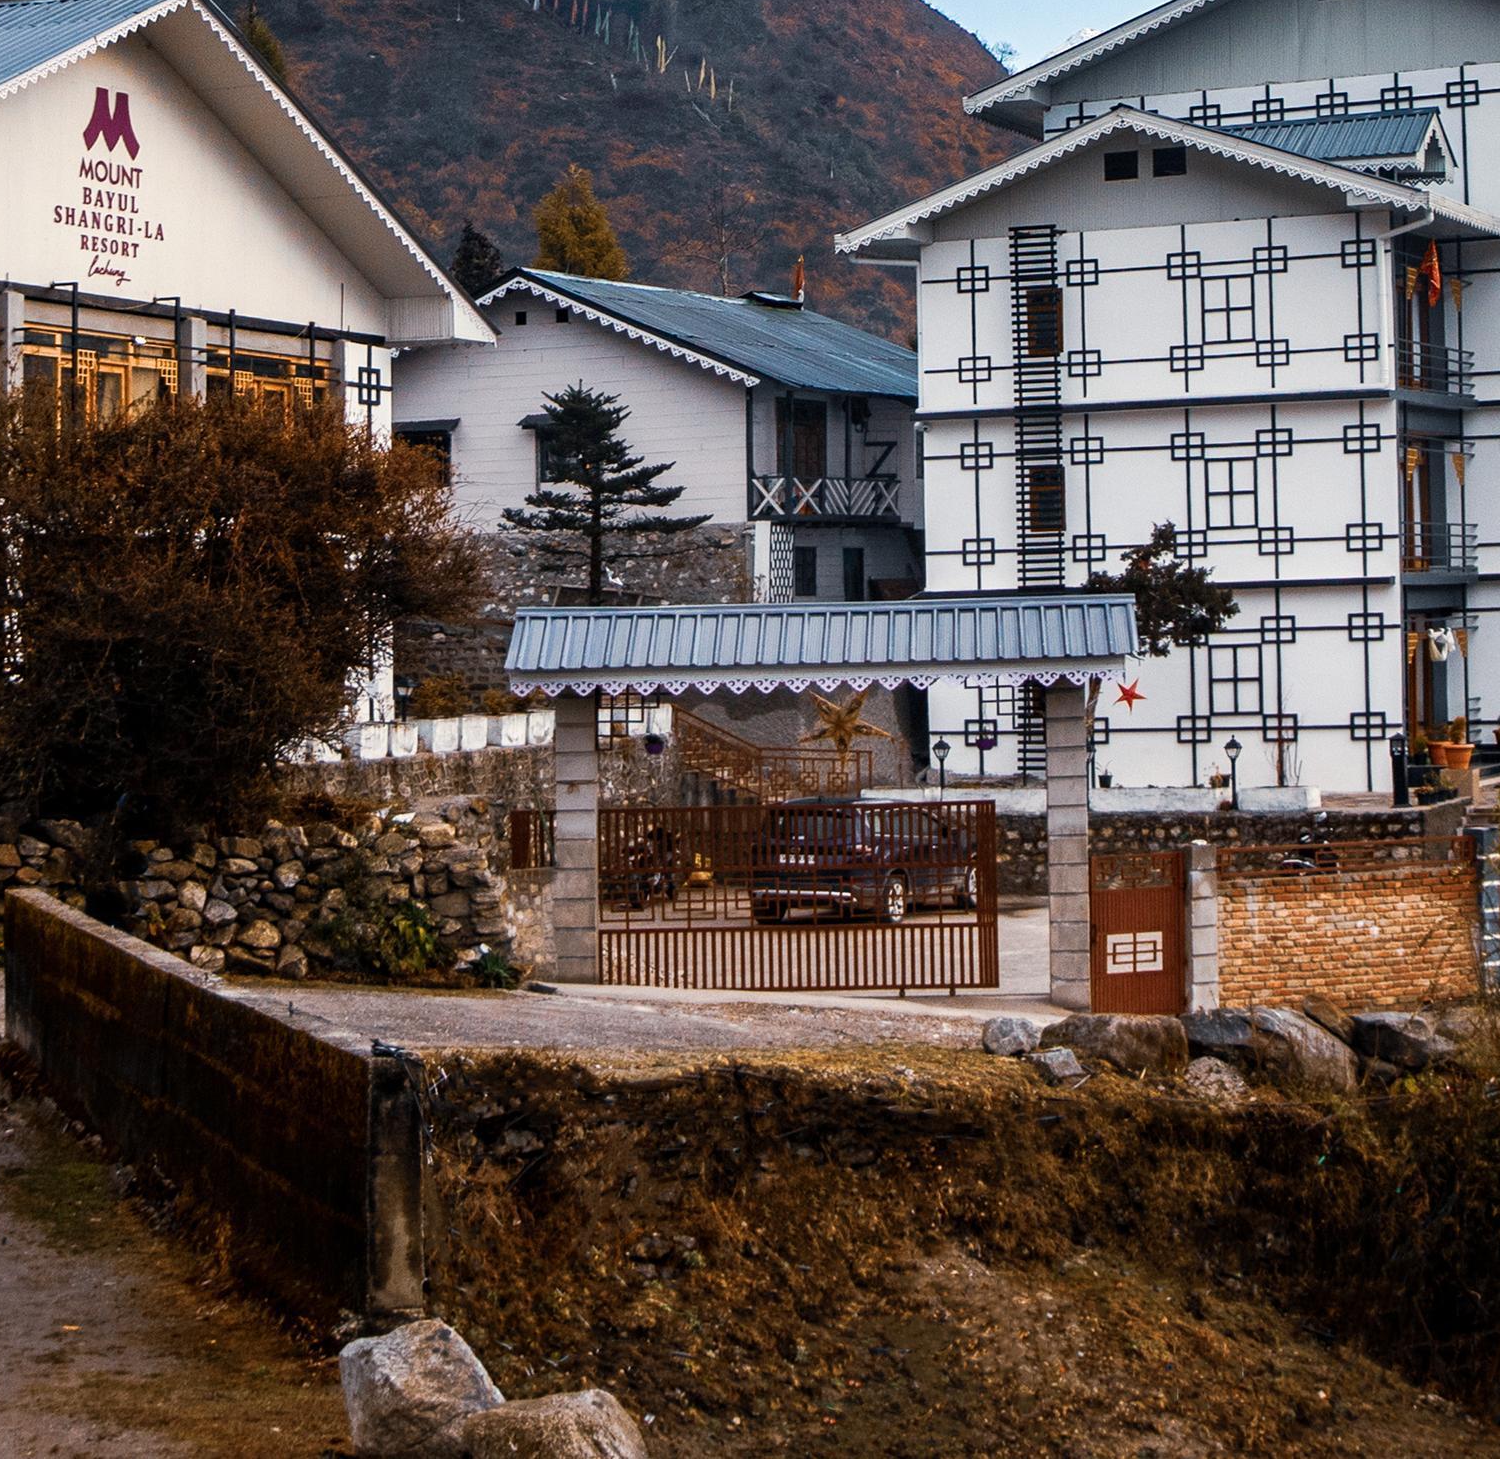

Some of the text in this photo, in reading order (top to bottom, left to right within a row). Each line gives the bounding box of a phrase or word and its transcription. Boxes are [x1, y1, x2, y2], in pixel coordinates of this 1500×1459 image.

[78, 157, 143, 189] MOUNT
[82, 186, 139, 214] BAYUL
[53, 205, 165, 242] SHANGRI-LA
[80, 234, 140, 259] RESORT
